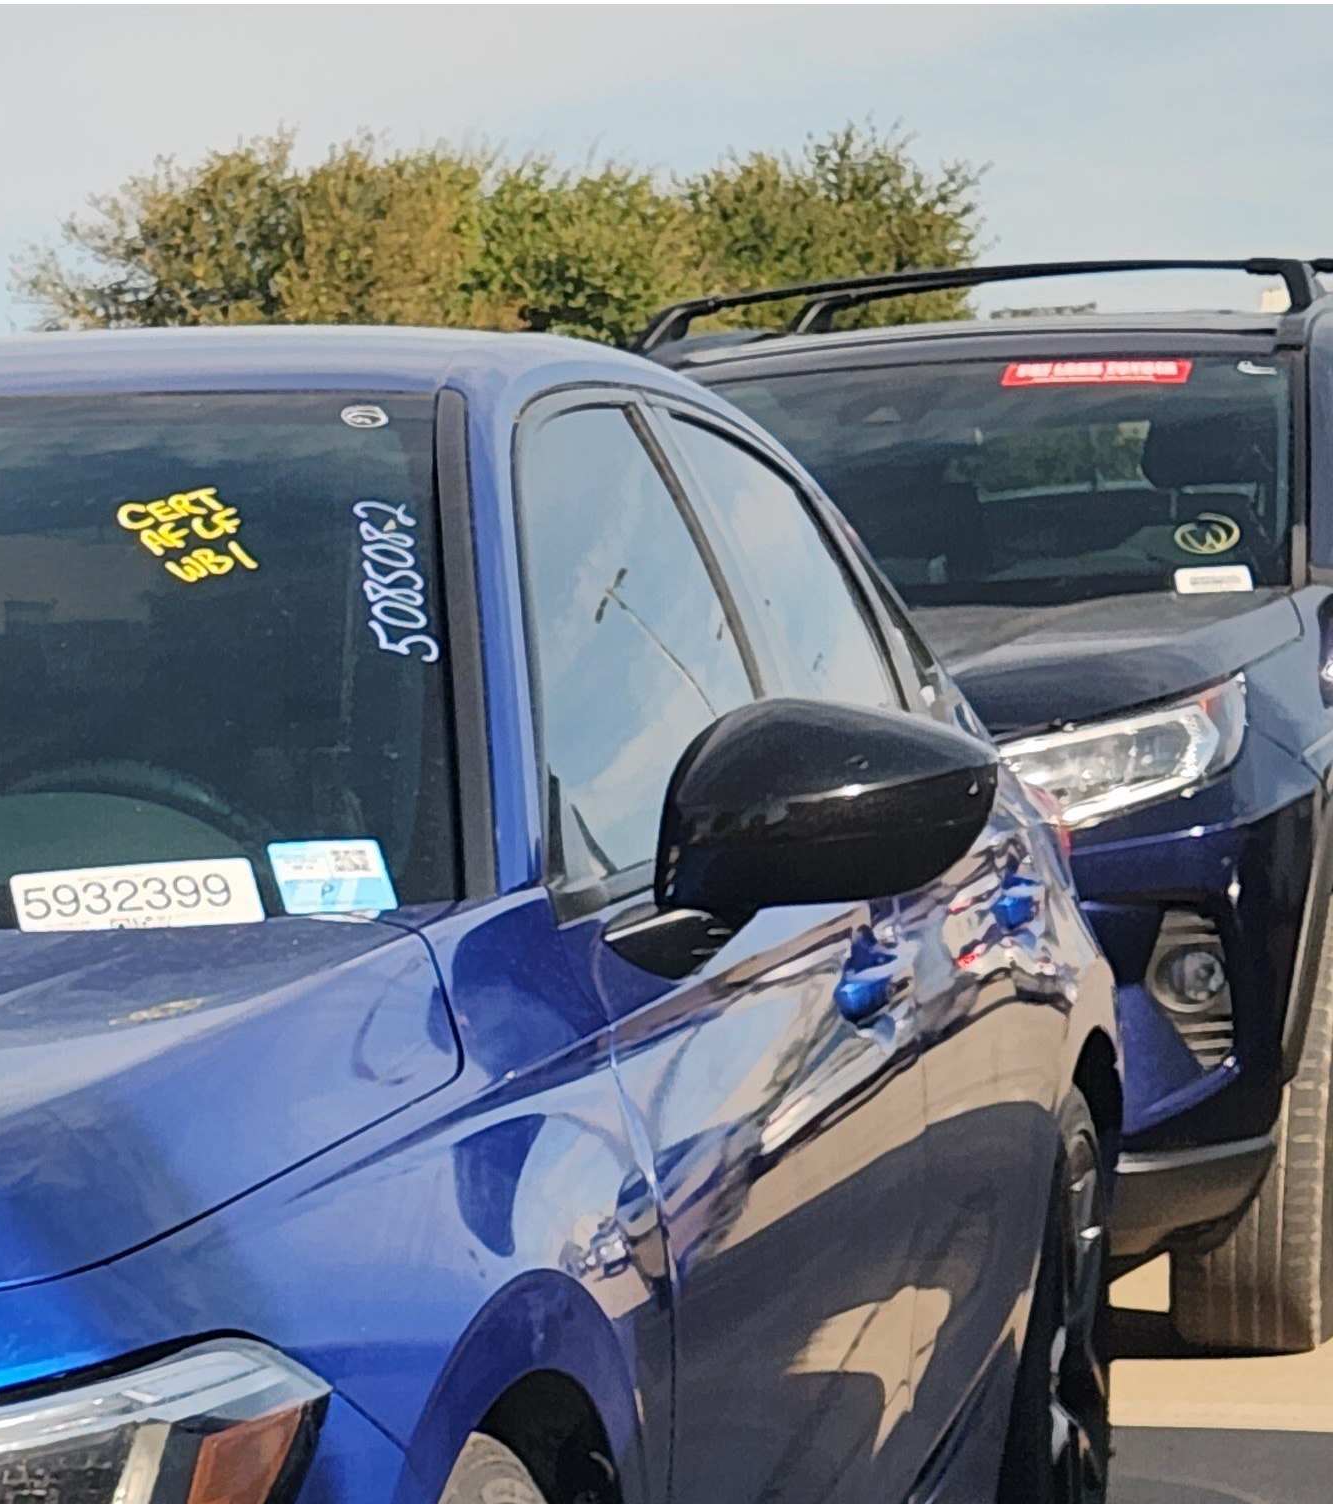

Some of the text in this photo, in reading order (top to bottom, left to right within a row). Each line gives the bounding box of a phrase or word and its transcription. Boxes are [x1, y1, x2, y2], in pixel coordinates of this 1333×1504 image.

[117, 487, 225, 530] CERT
[352, 501, 439, 662] 5085082
[22, 873, 232, 920] 5932399
